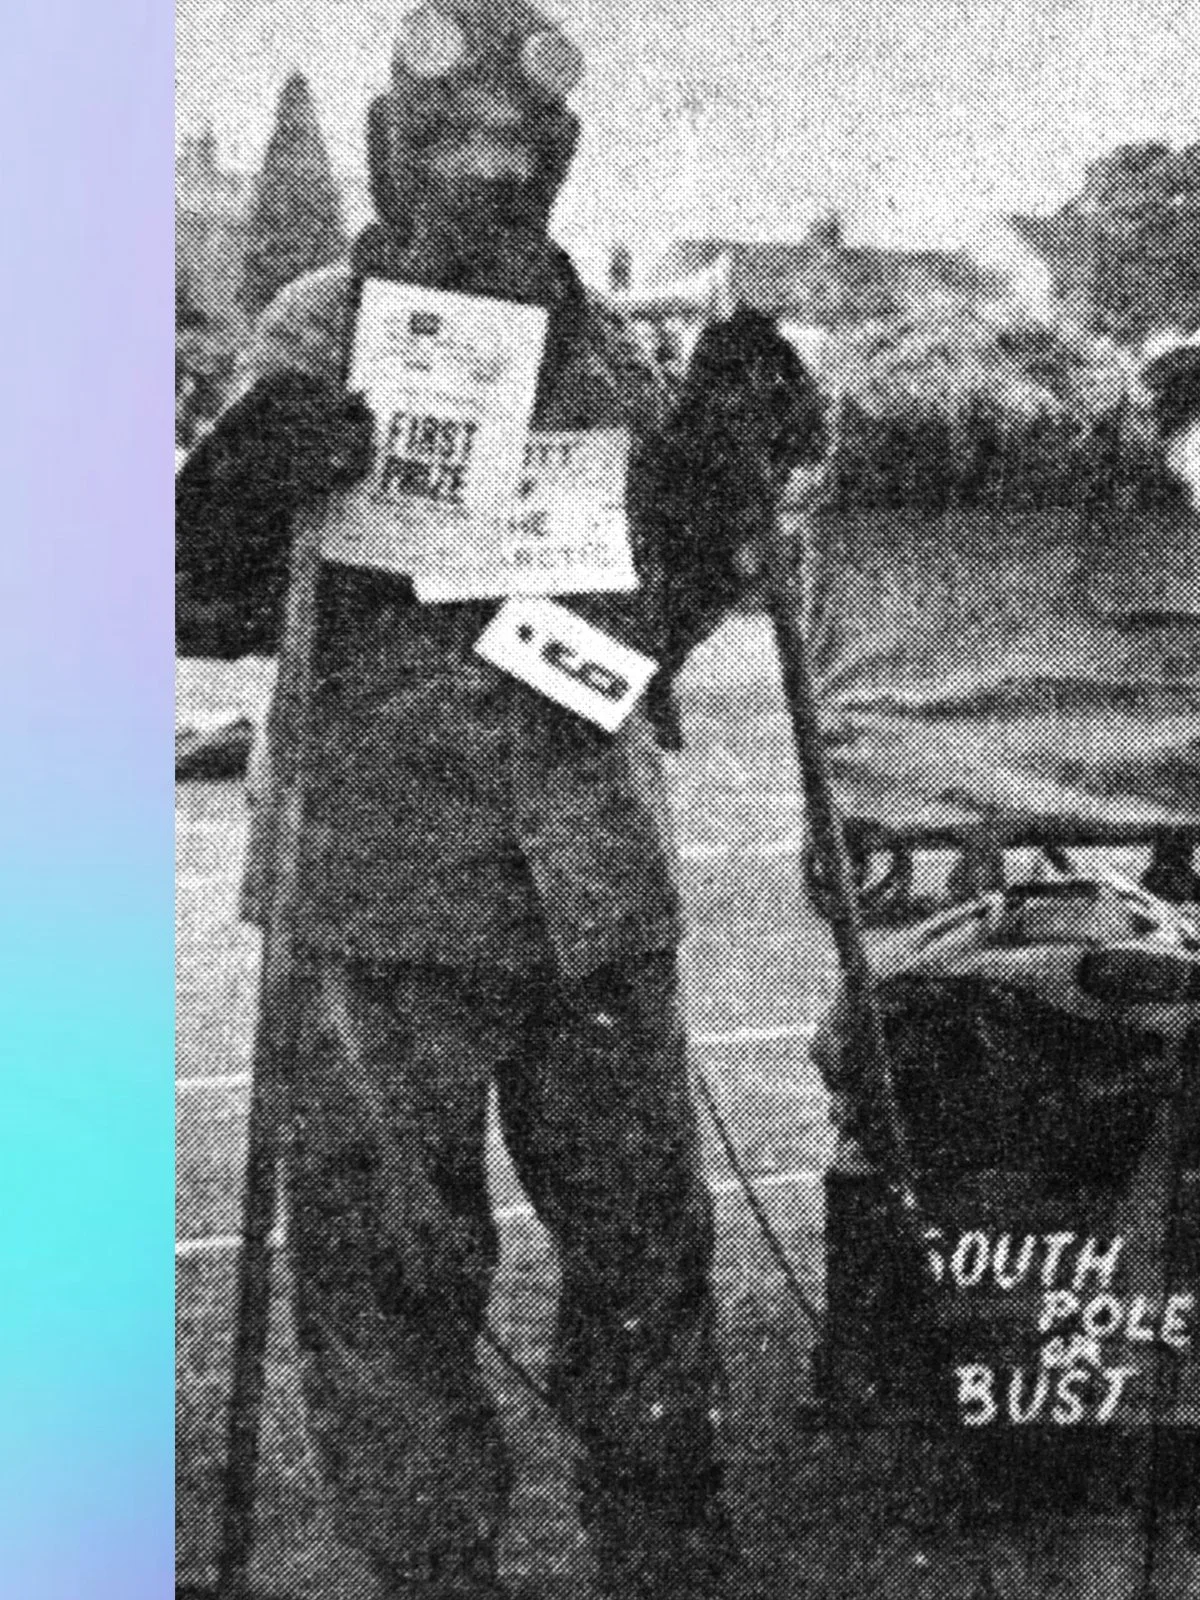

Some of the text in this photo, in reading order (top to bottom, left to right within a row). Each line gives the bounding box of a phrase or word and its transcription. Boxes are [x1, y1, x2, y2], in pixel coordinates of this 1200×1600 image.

[388, 410, 480, 459] FIRST
[381, 456, 466, 495] PRIZE
[1037, 1289, 1196, 1347] POLE
[954, 1363, 1141, 1426] BUST
